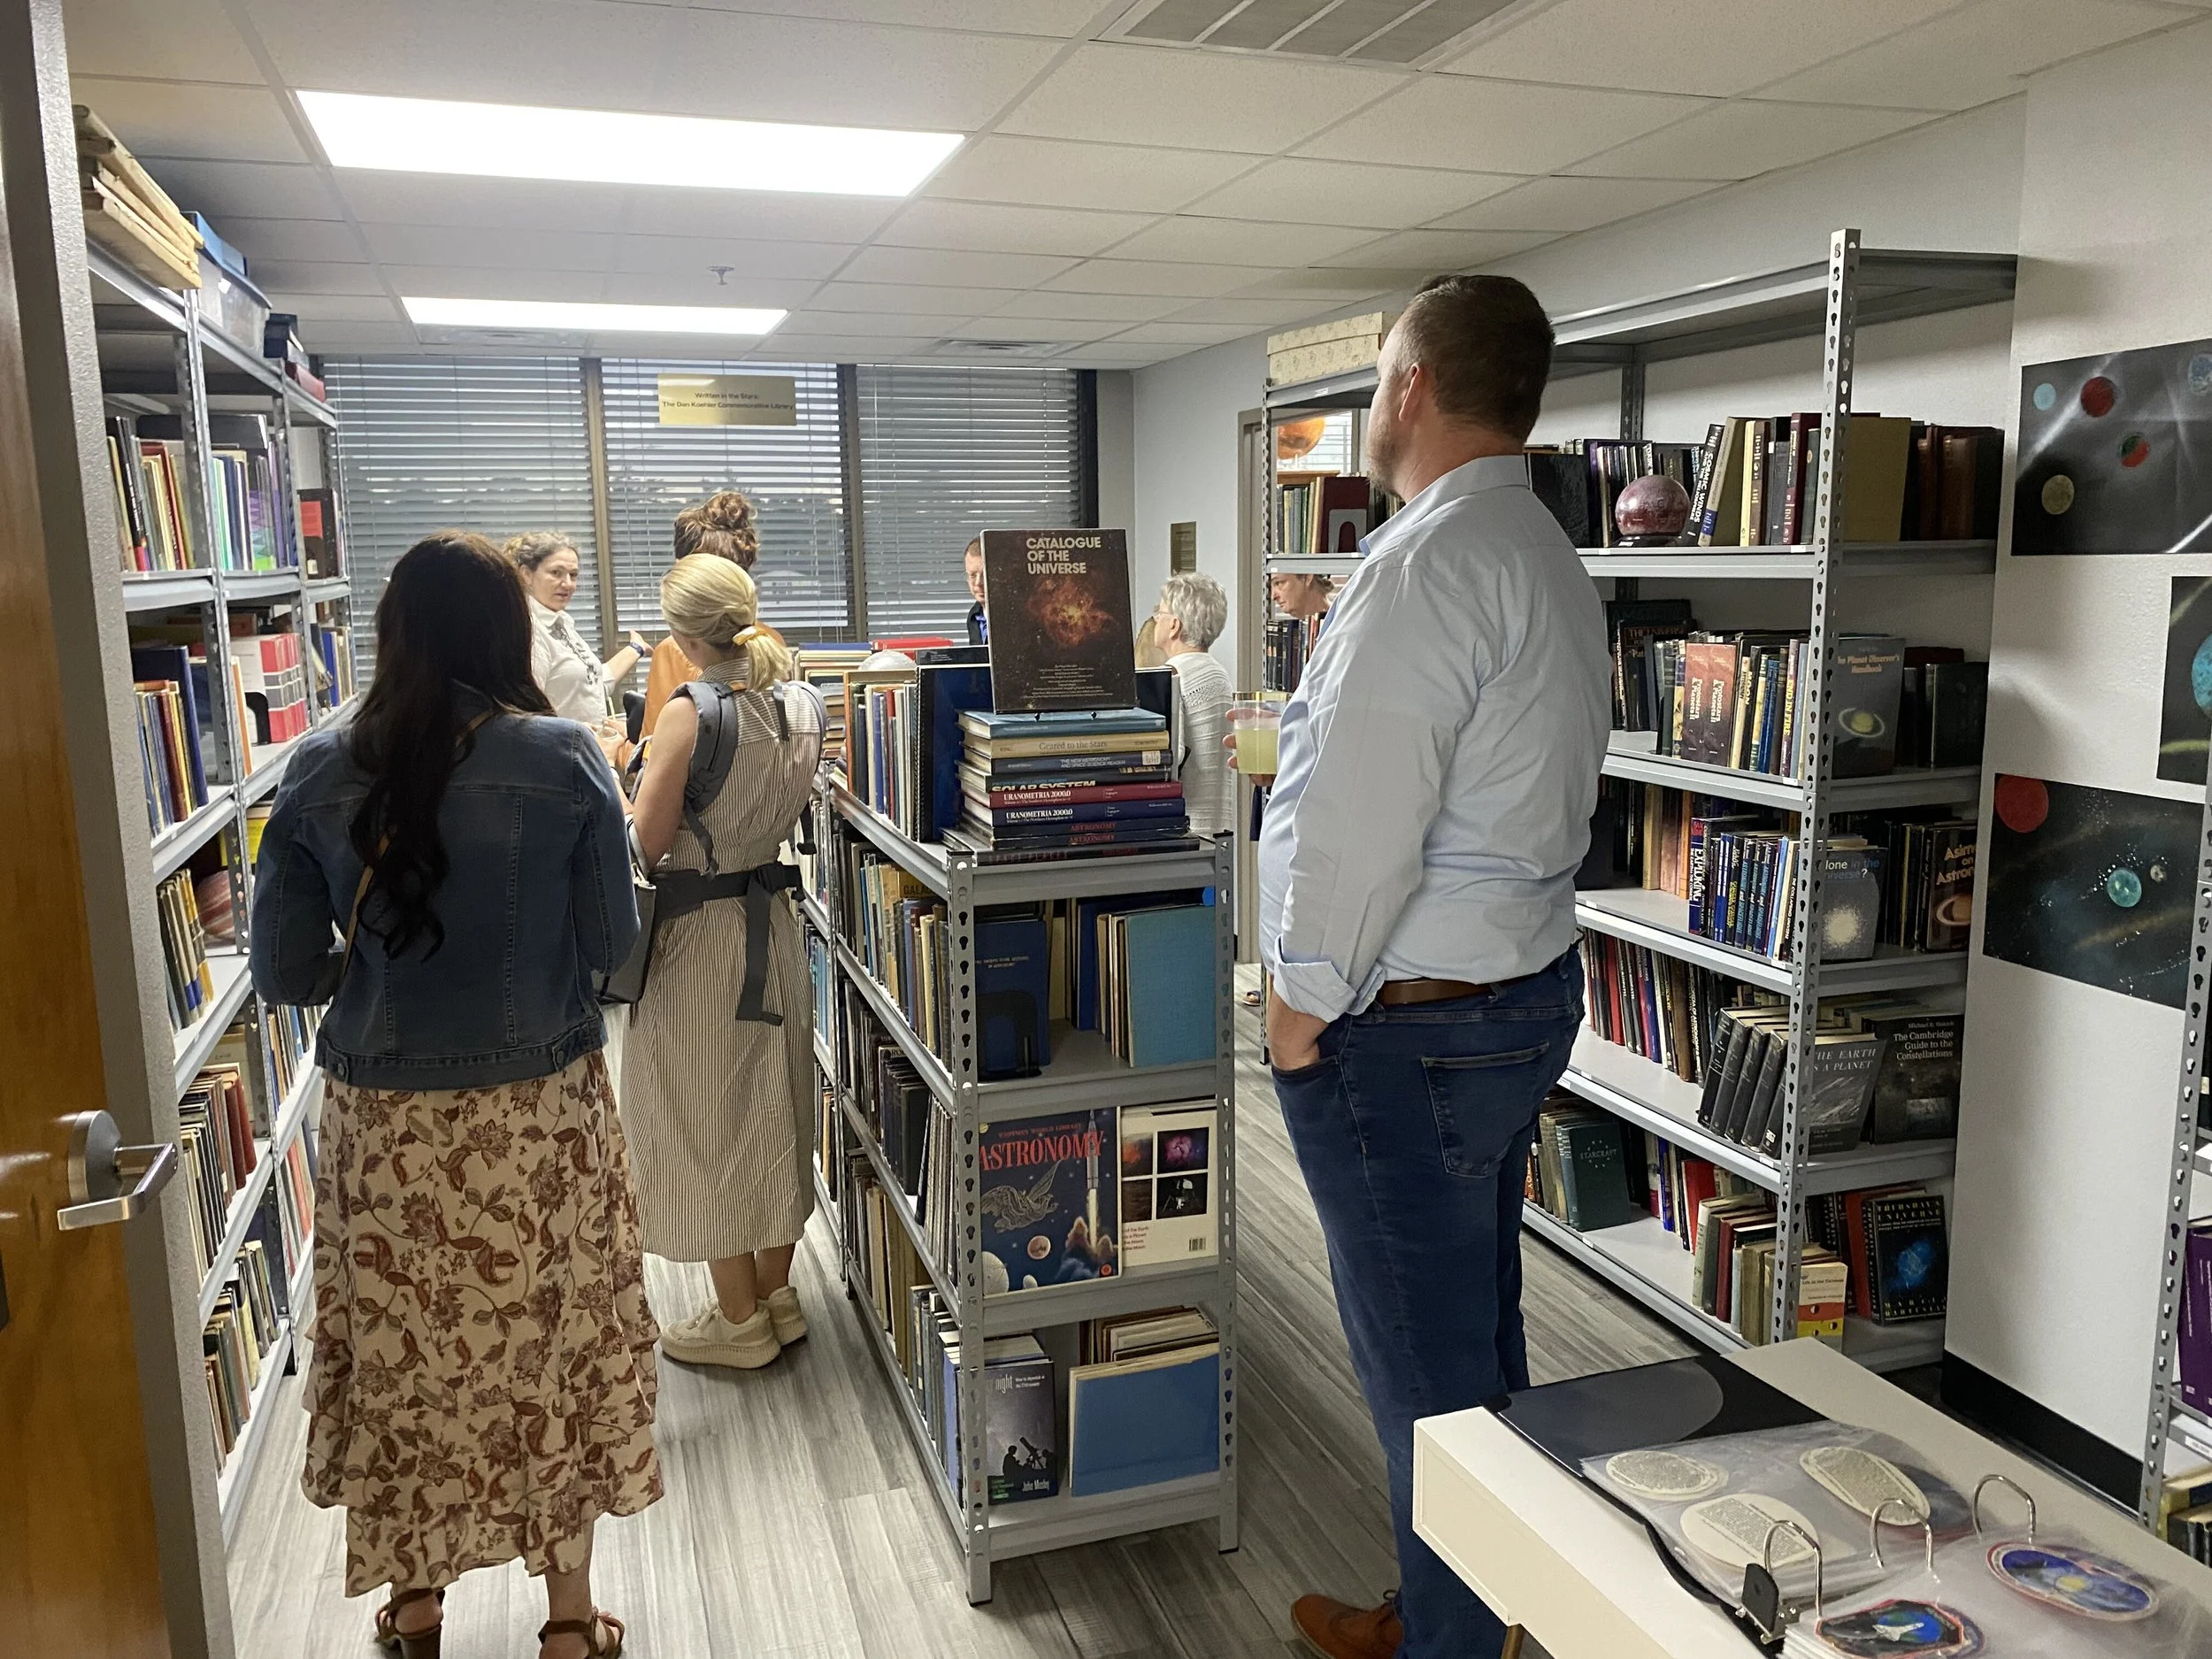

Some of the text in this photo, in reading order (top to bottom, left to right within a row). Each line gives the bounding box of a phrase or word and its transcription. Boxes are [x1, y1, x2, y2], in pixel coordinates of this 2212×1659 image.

[1700, 452, 1715, 490] COSMIC
[1693, 492, 1706, 523] WINDS
[1025, 537, 1102, 549] CATALOGUE
[1027, 550, 1070, 562] OF THE
[1027, 563, 1087, 574] UNIVERSE
[1709, 687, 1718, 716] Planets
[1715, 680, 1724, 721] Protostars
[1782, 678, 1793, 735] END IN FIRE
[1039, 780, 1095, 789] SYSTEM
[1071, 821, 1117, 831] ASTRONOMY
[1070, 833, 1115, 842] ASTRONOMY
[1944, 844, 1975, 860] Asim
[1825, 860, 1847, 870] lone
[1962, 856, 1973, 865] on
[1693, 848, 1703, 901] EXPLORING
[1936, 867, 1975, 885] Astron
[1909, 1030, 1954, 1040] Cambridge
[1905, 1041, 1928, 1050] Guide
[1839, 1048, 1876, 1058] EARTH
[1897, 1049, 1954, 1060] Constellations
[1834, 1060, 1872, 1071] PLANET
[980, 1131, 1104, 1171] ASTRONOMY
